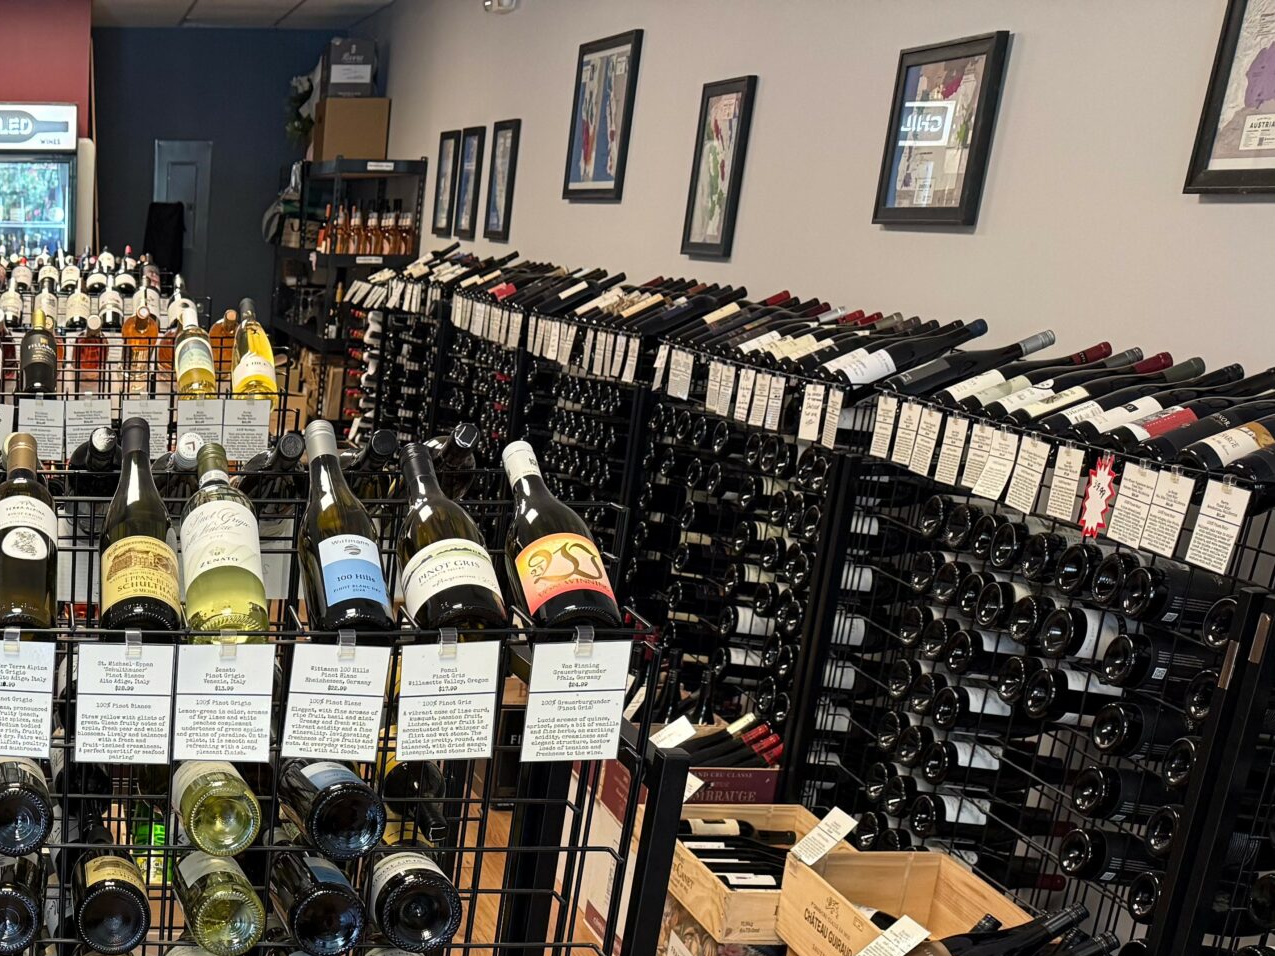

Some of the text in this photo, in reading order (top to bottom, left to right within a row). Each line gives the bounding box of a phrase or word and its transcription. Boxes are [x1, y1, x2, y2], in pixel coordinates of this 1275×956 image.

[200, 557, 240, 568] ZENATO
[418, 560, 481, 583] PINOT GRIS
[337, 573, 376, 583] 100 Hills
[333, 585, 350, 593] PINOT
[804, 908, 828, 939] CHÂTEAU
